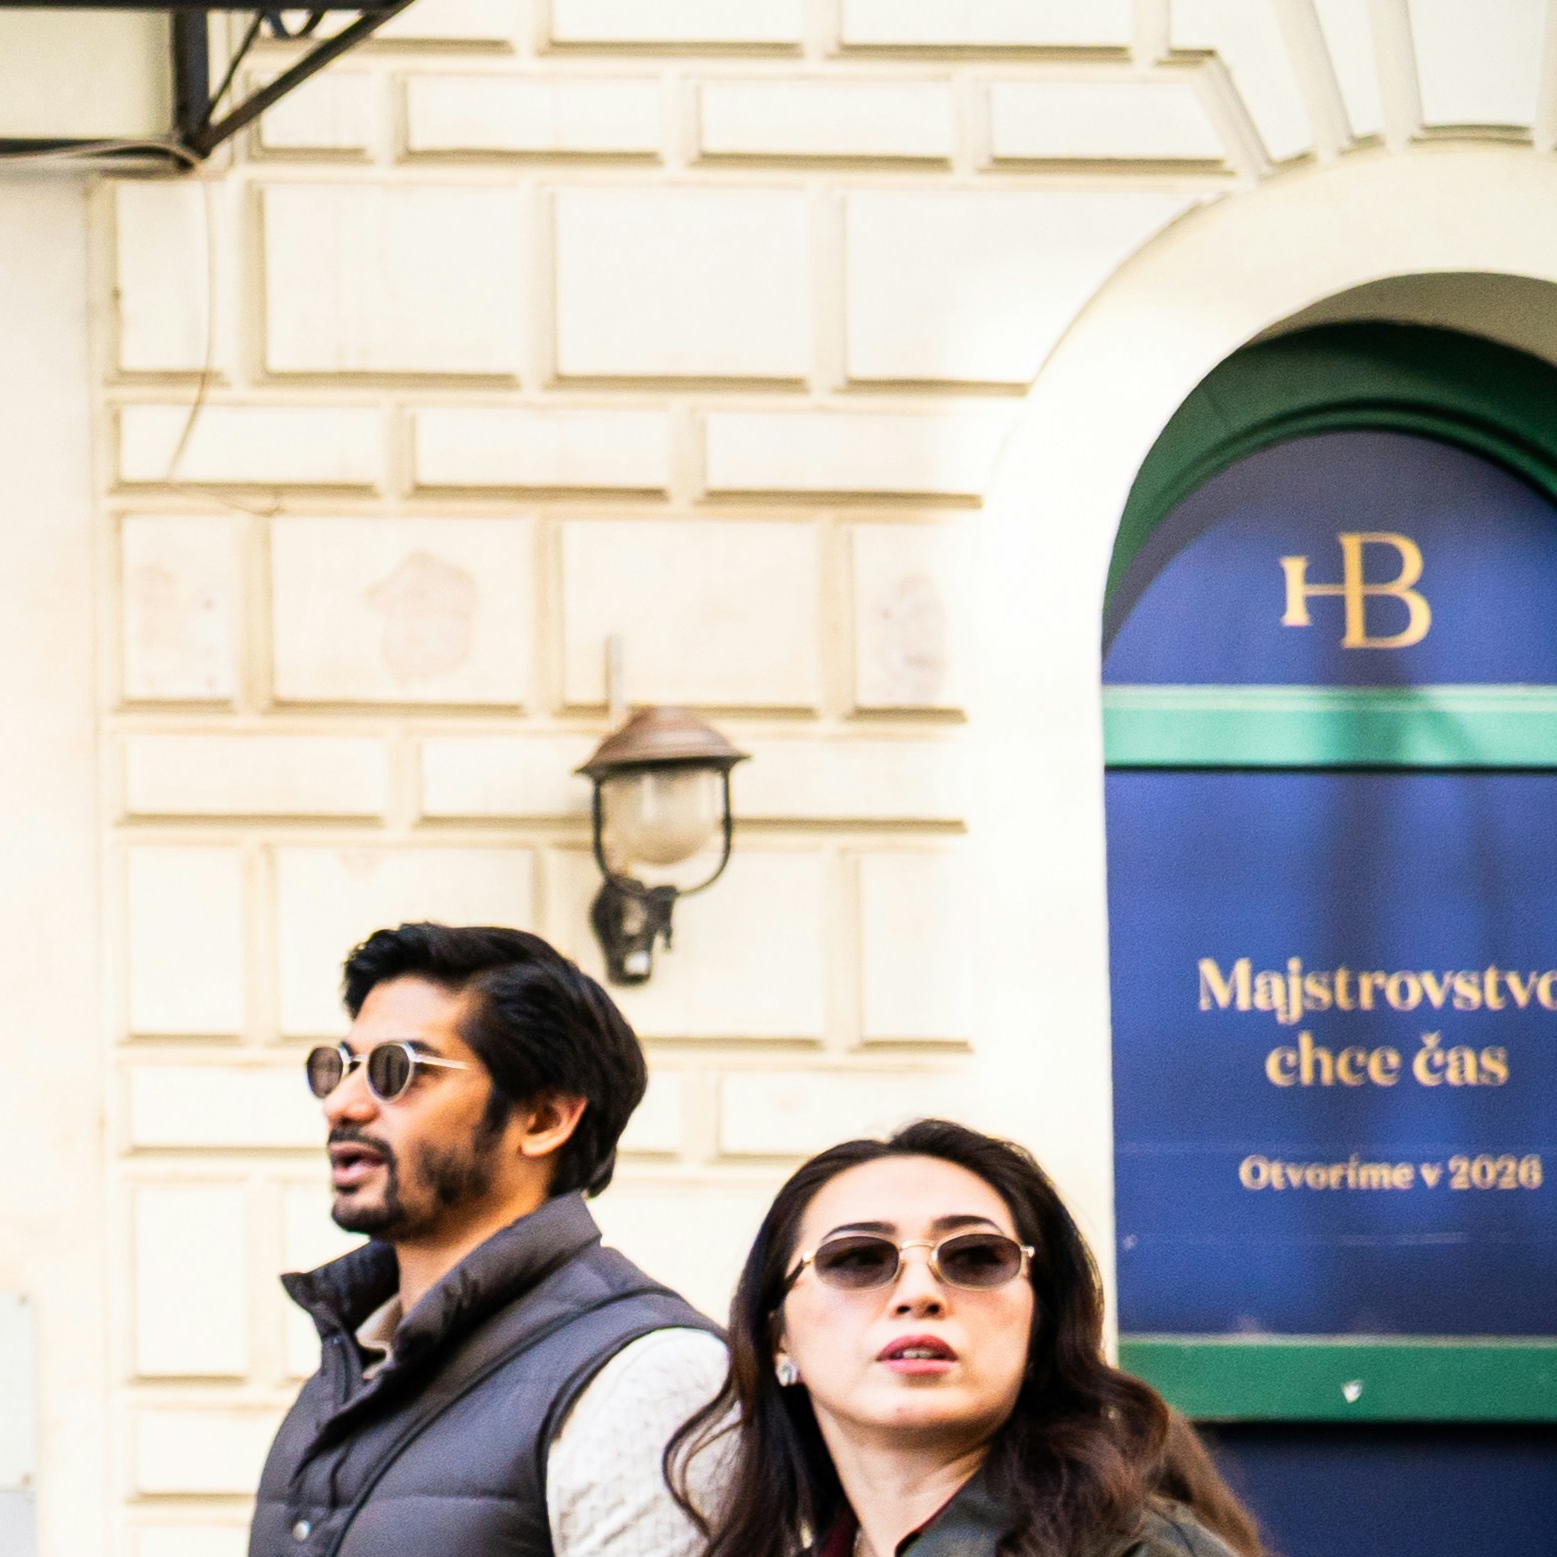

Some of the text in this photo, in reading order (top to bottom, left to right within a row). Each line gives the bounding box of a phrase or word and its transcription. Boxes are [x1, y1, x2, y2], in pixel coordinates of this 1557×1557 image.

[1279, 531, 1433, 650] HB
[1264, 1029, 1511, 1088] chce čas
[1238, 1152, 1544, 1191] Otvoríme v 2026
